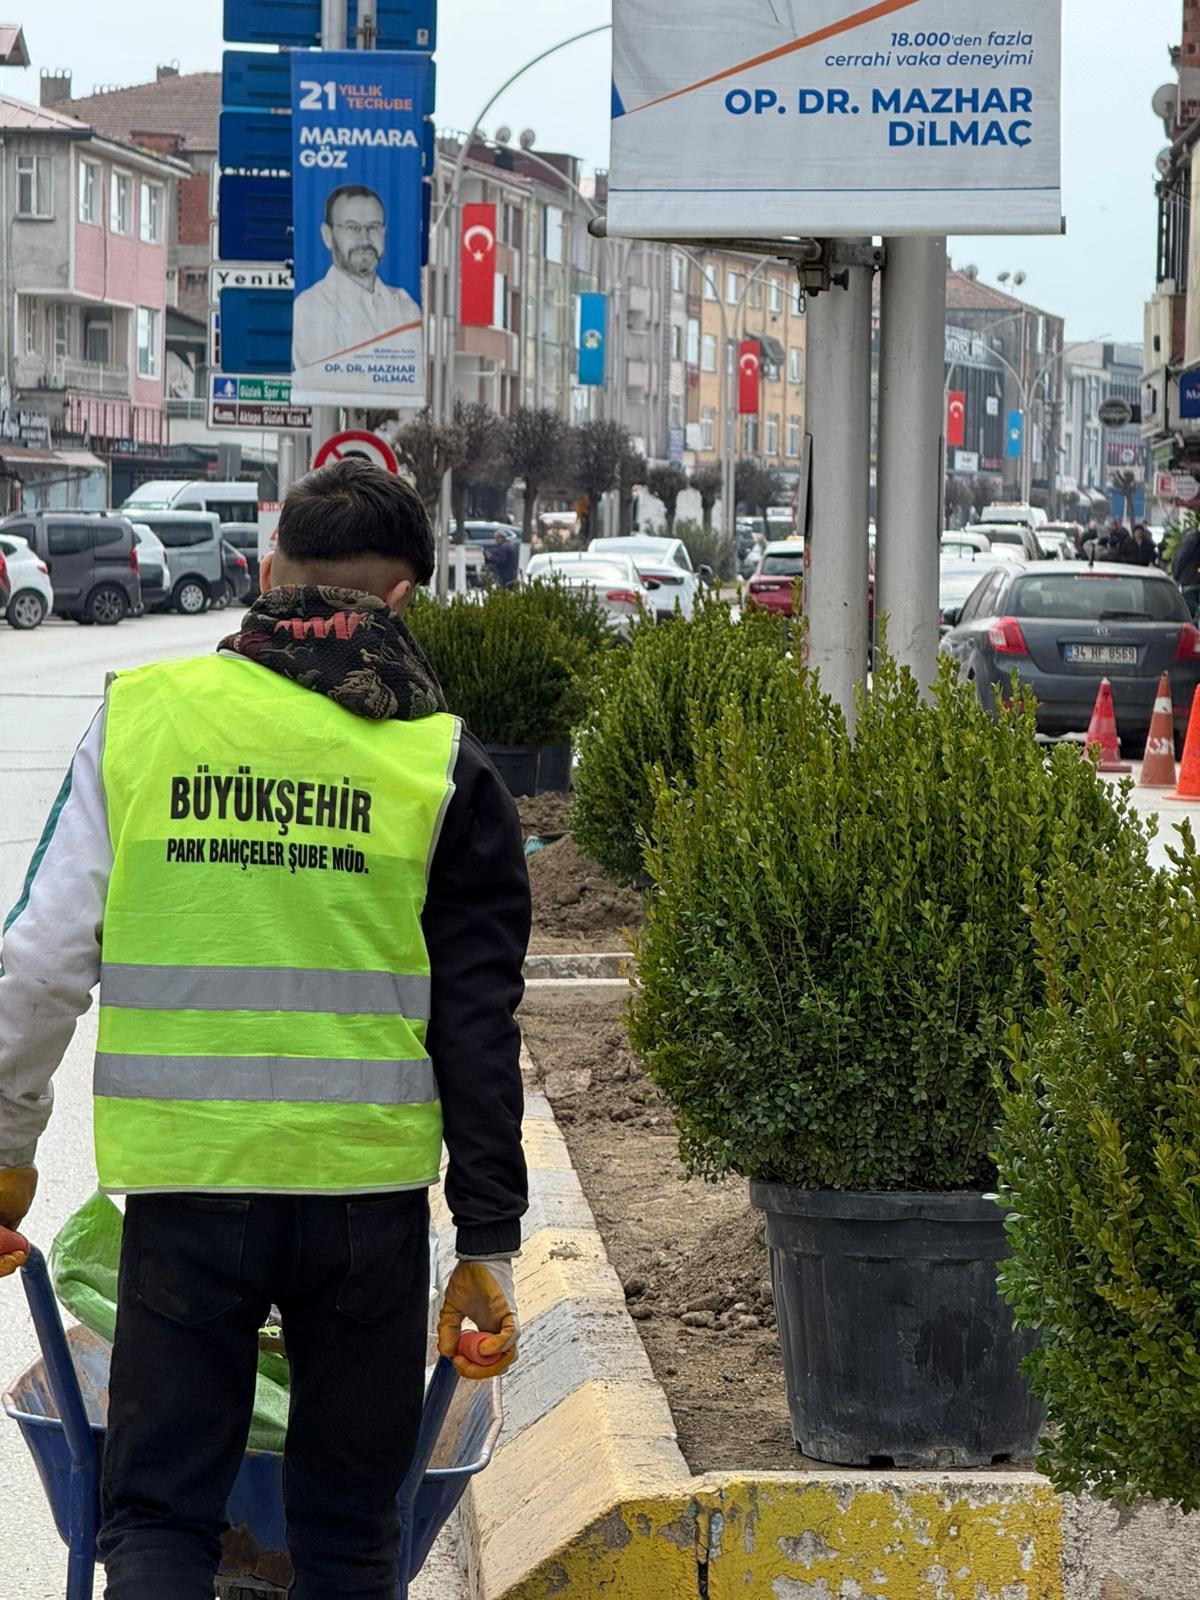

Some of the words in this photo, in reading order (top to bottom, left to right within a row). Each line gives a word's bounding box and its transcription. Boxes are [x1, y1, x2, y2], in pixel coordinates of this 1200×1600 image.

[987, 30, 1033, 47] fazla
[825, 51, 891, 66] cerrahi
[897, 51, 941, 66] vaka
[946, 49, 1034, 69] deneyimi
[299, 80, 337, 111] 21
[339, 84, 383, 97] YILLIK
[724, 88, 787, 115] OP.
[799, 88, 860, 115] DR.
[871, 87, 1033, 114] MAZHAR
[299, 126, 418, 148] MARMARA
[888, 119, 1033, 149] DİLMAÇ
[299, 145, 348, 168] GÖZ
[324, 363, 344, 373] OP.
[346, 363, 365, 373] DR.
[367, 364, 416, 373] MAZHAR
[170, 764, 371, 836] BÜYÜKŞEHİR
[166, 838, 206, 863] PARK
[209, 838, 285, 870] BAHÇELER
[288, 842, 328, 874] ŞUBE
[332, 843, 370, 874] MÜD.
